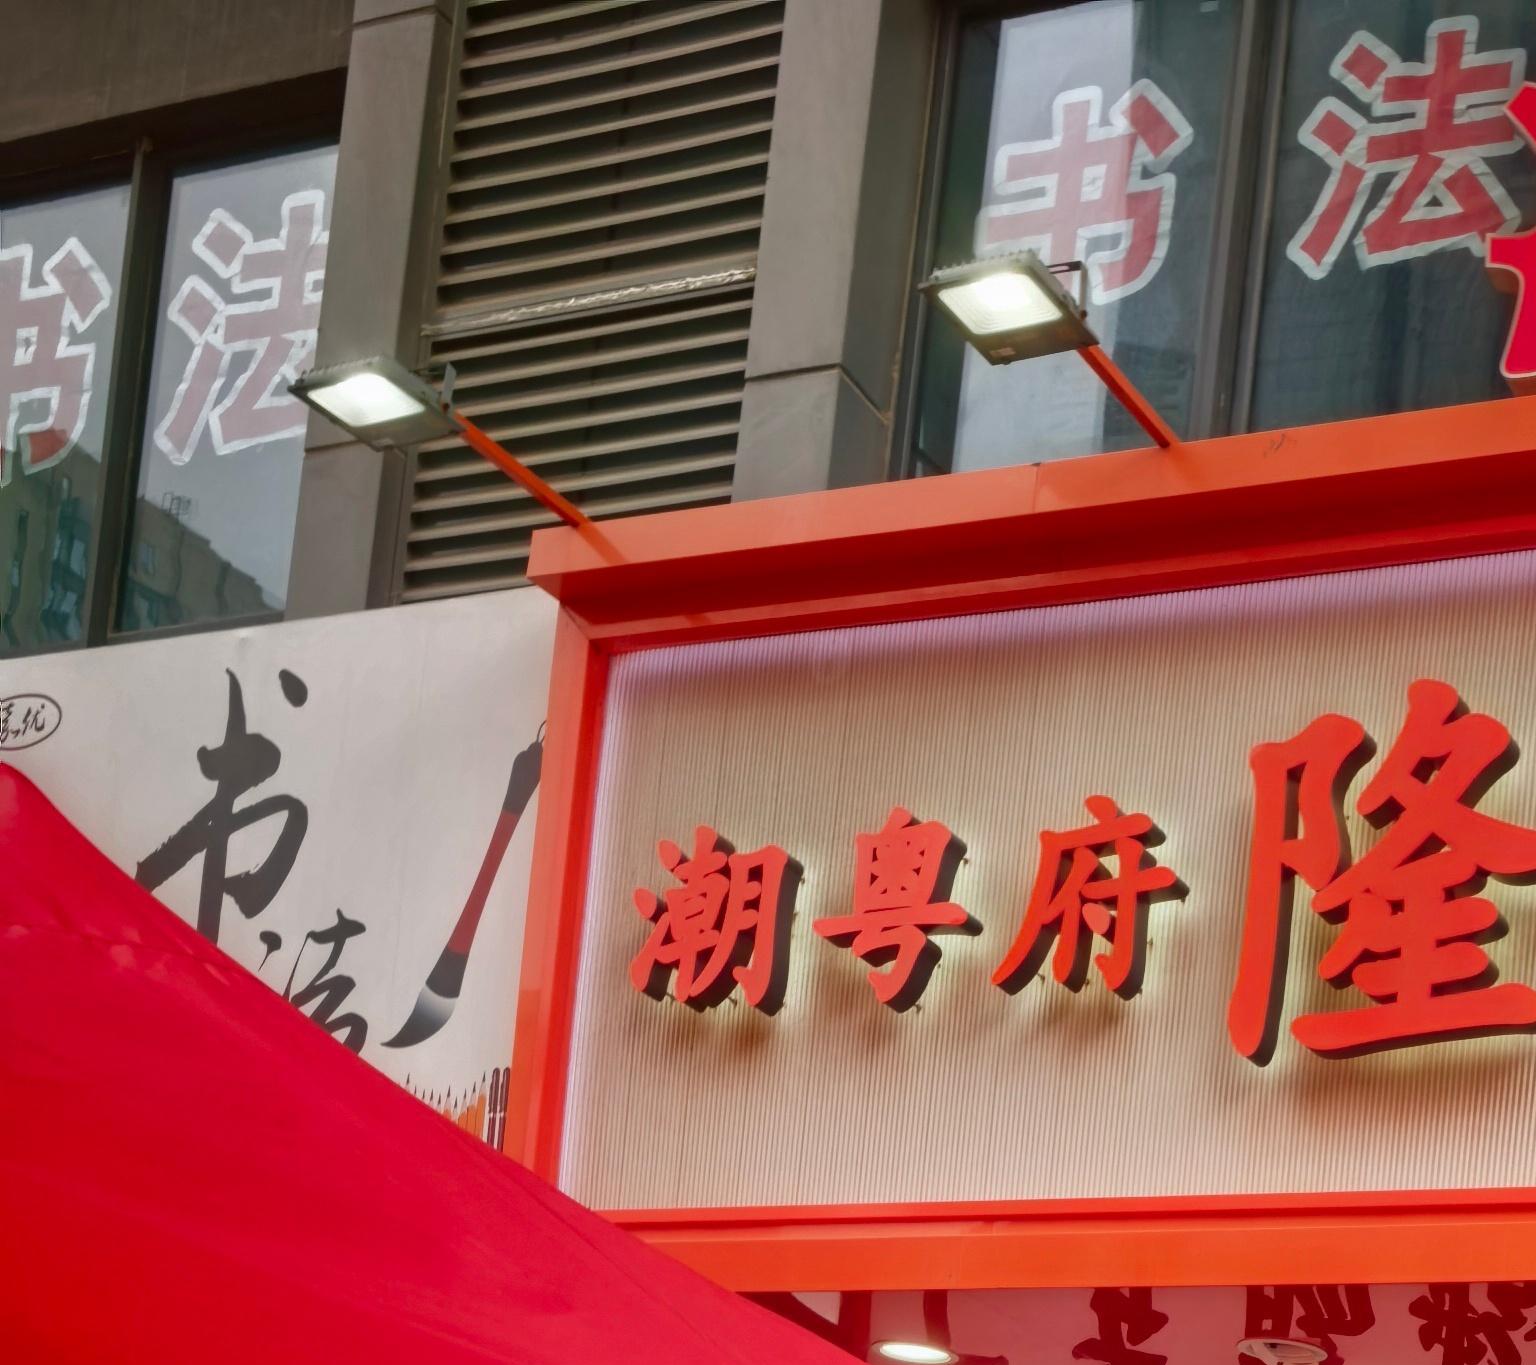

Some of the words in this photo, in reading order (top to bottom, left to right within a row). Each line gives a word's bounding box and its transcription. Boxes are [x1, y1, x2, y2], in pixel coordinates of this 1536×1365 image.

[975, 15, 1527, 305] 书法
[630, 795, 1180, 1008] 潮粤府
